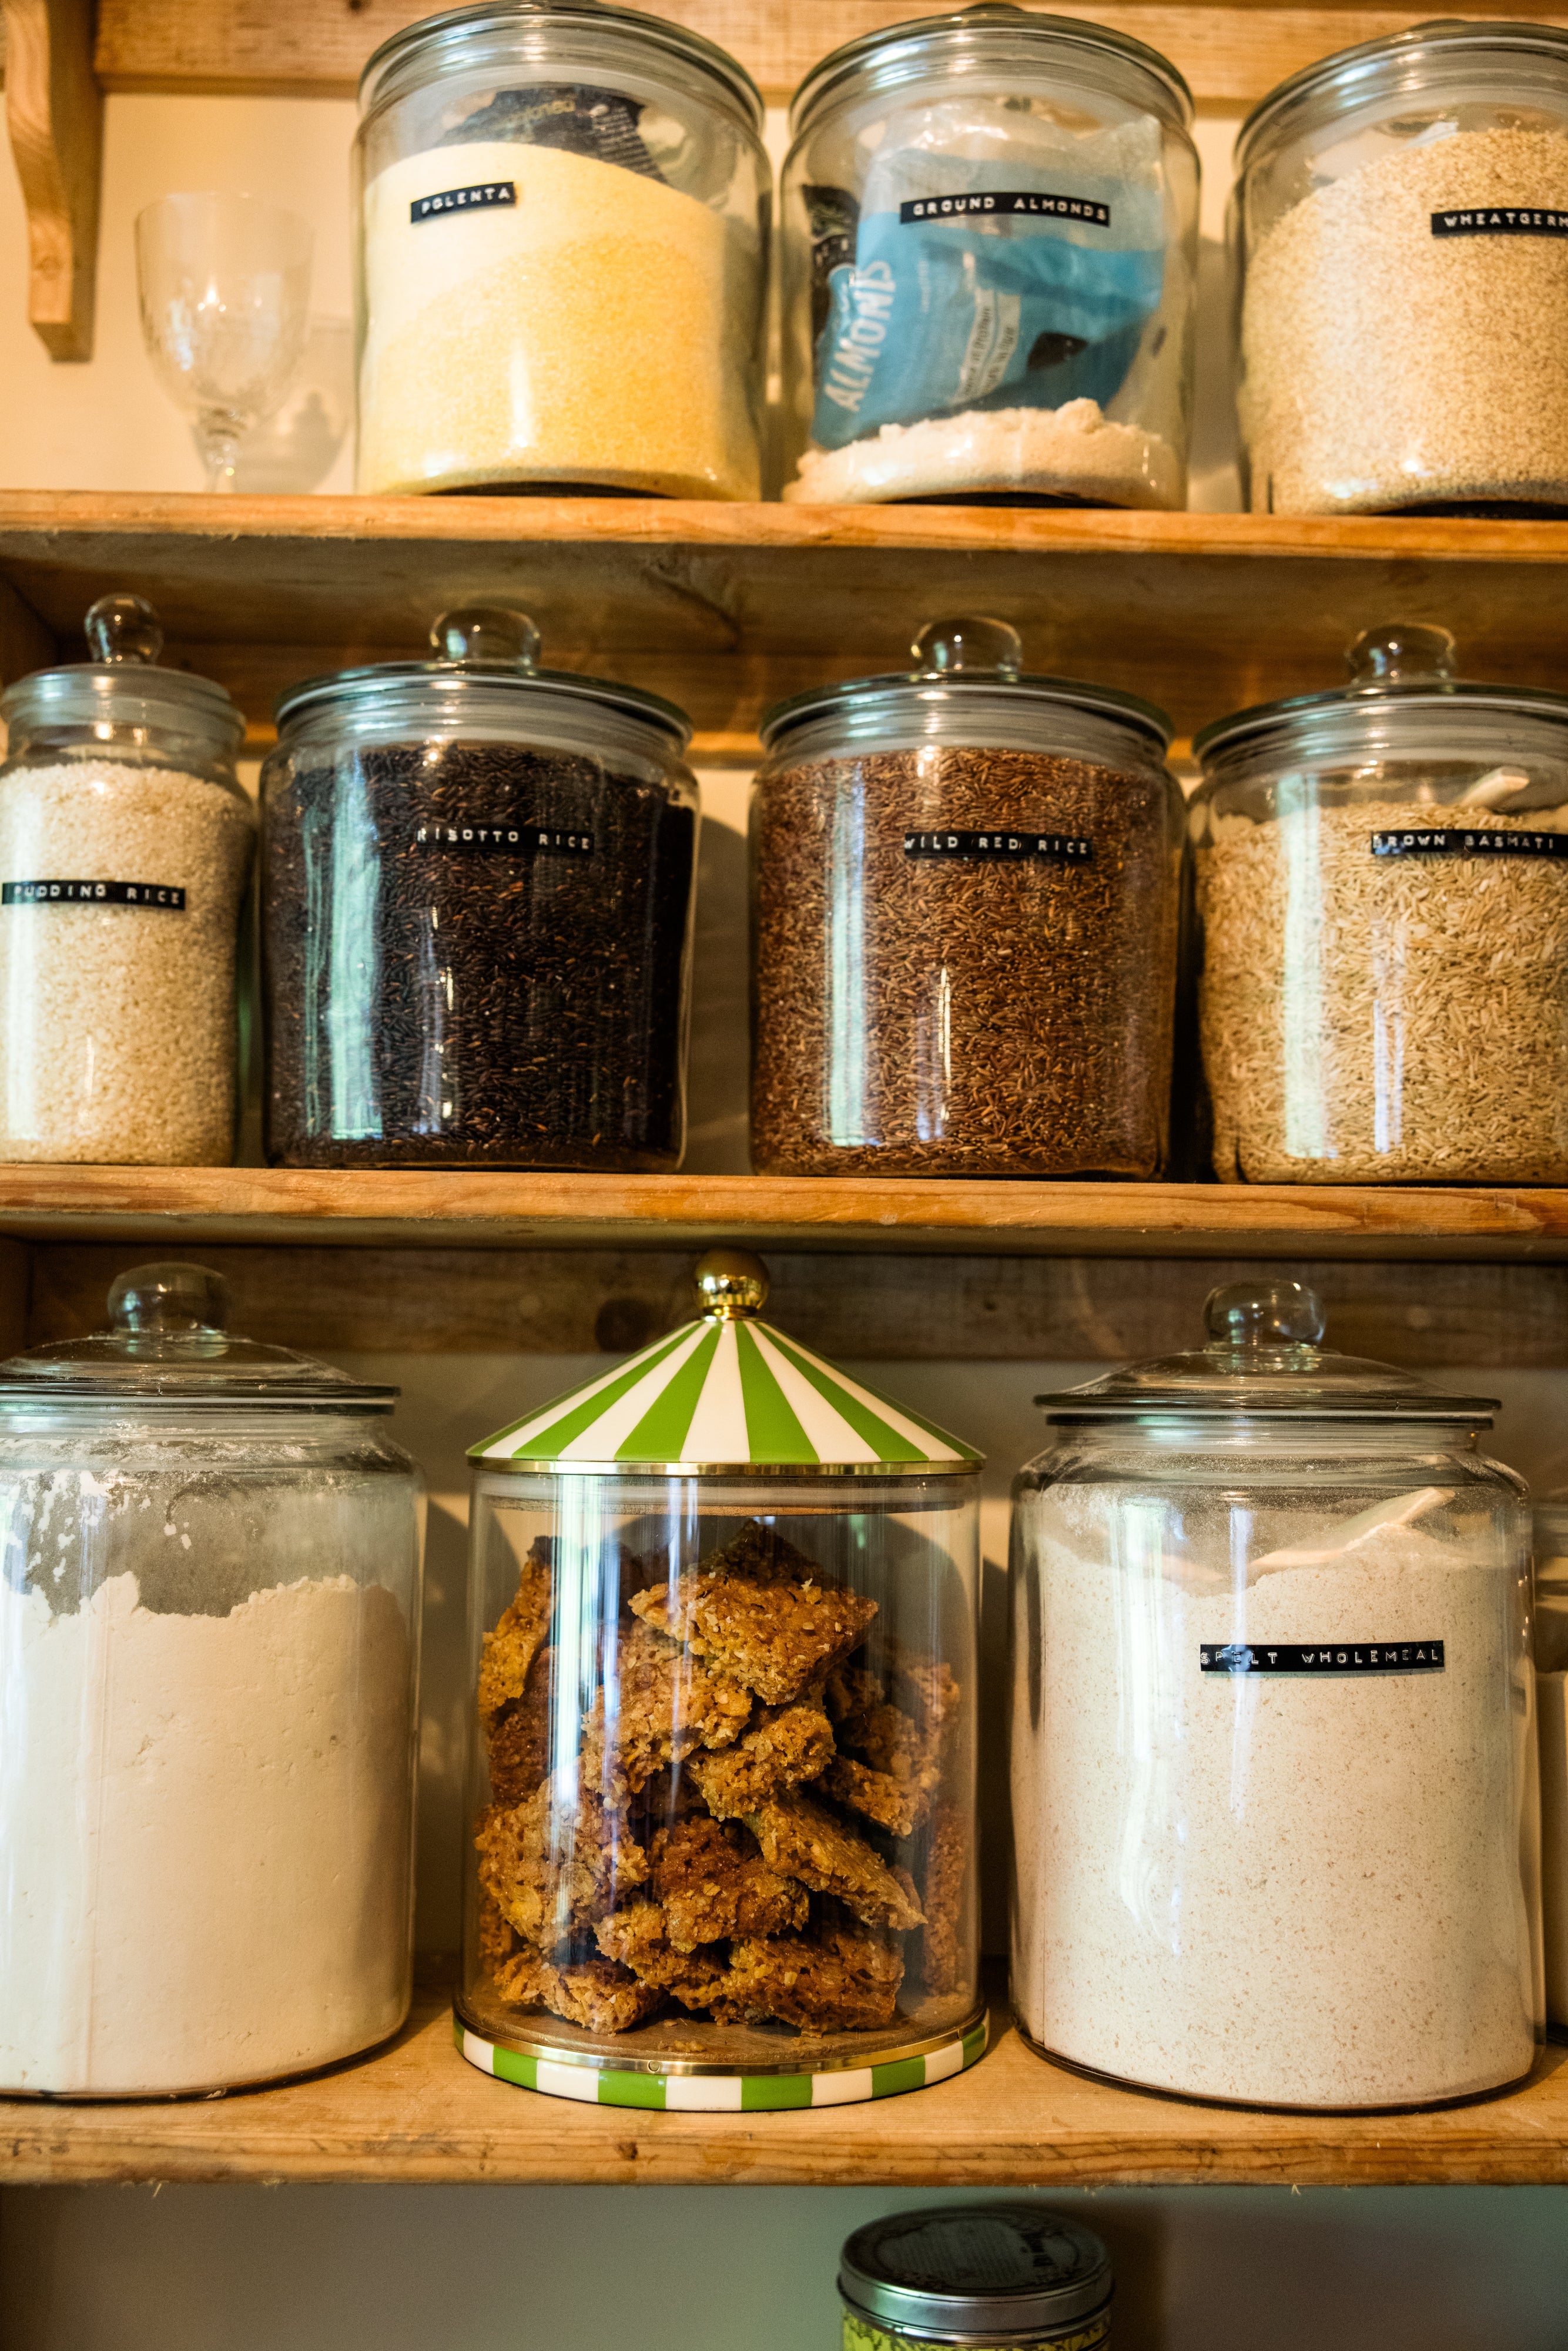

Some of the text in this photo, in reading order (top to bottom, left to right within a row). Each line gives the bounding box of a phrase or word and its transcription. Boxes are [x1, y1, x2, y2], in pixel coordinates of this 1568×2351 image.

[421, 186, 511, 215] POLENTA
[913, 196, 1107, 222] GROUND ALMONDS
[417, 828, 590, 850] RISOTTO RICE
[904, 835, 1088, 855] WILD RED RICE
[1372, 834, 1554, 850] BROWN BASMATI
[13, 883, 180, 905] PUDDING RICE
[1200, 1649, 1439, 1665] SPELT WHOLEMEAL
